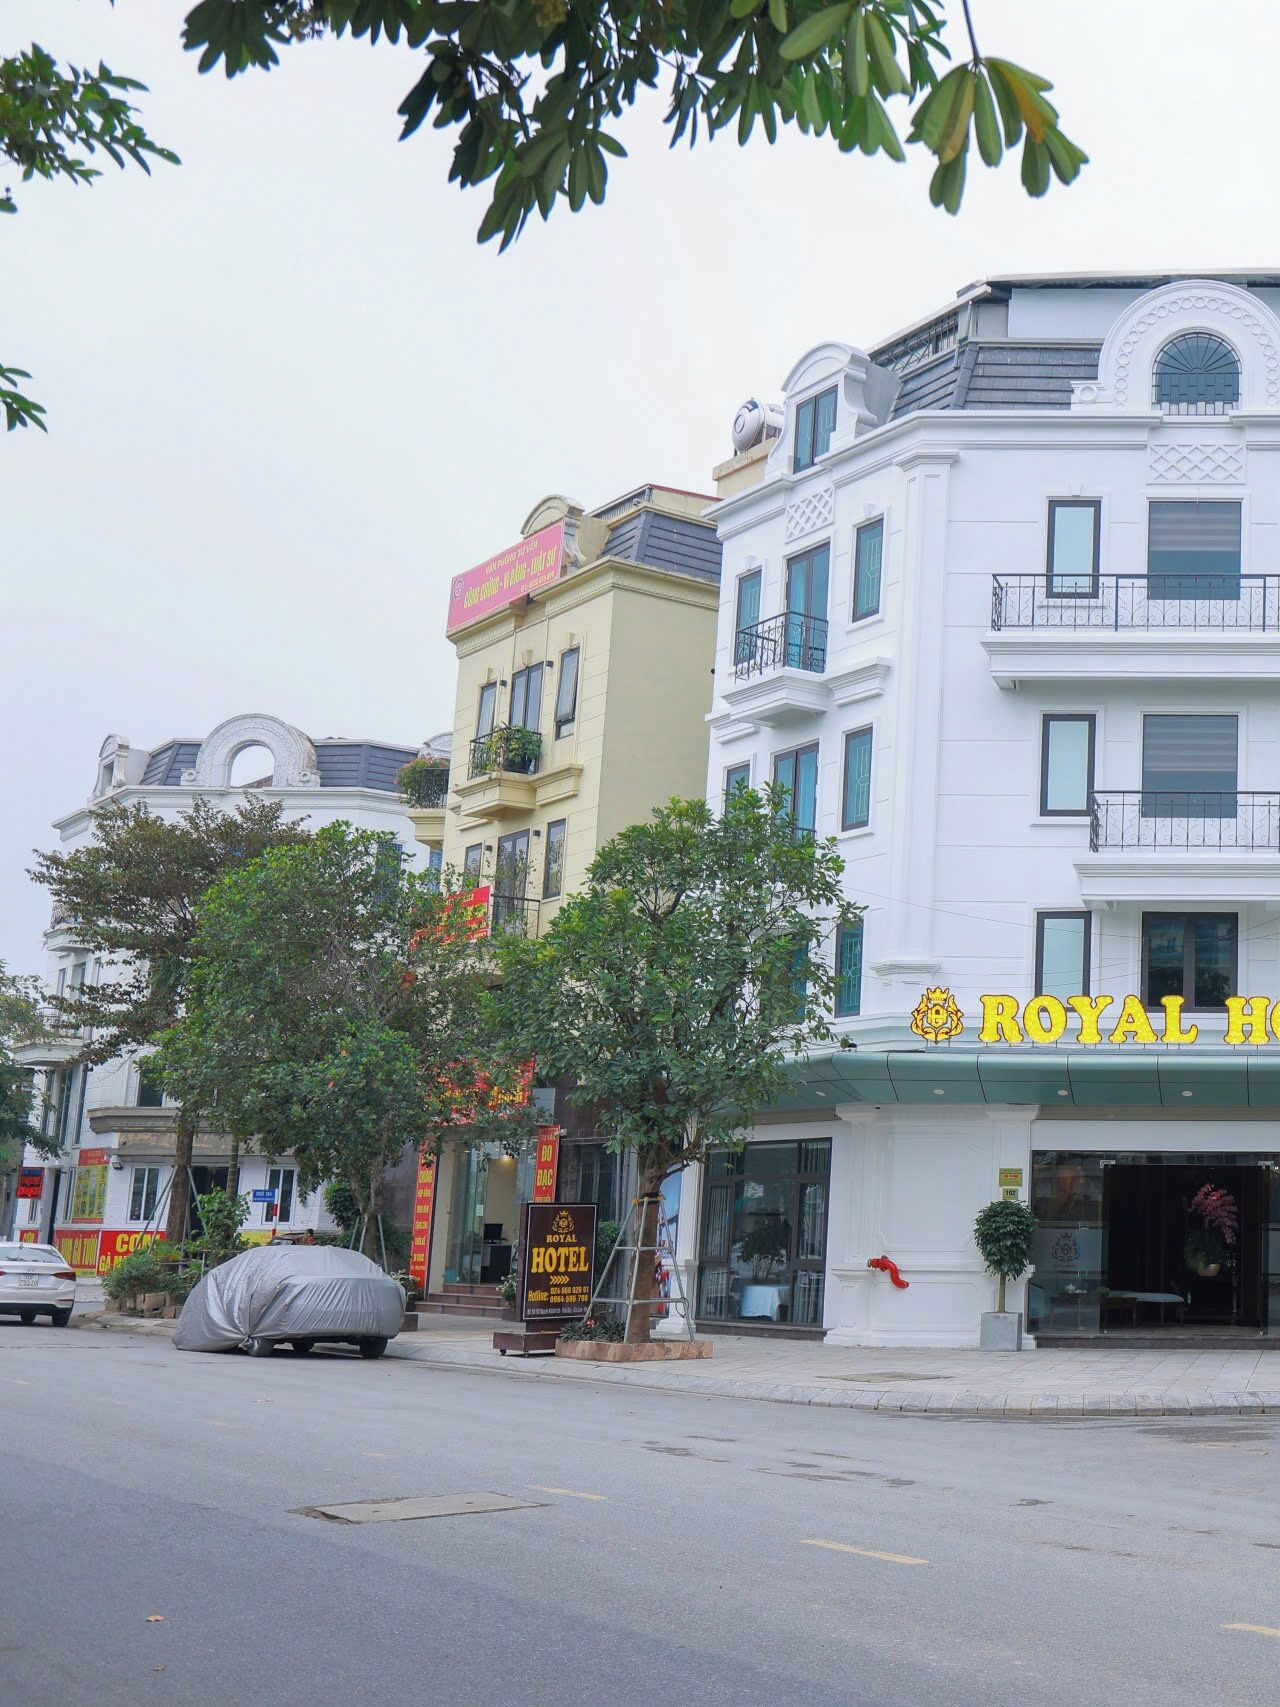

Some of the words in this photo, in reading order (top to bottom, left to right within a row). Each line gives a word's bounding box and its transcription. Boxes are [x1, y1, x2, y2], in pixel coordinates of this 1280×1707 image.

[978, 994, 1199, 1044] ROYAL
[537, 1169, 553, 1190] ĐẠC
[546, 1234, 577, 1243] ROYAL
[530, 1246, 588, 1273] HOTEL
